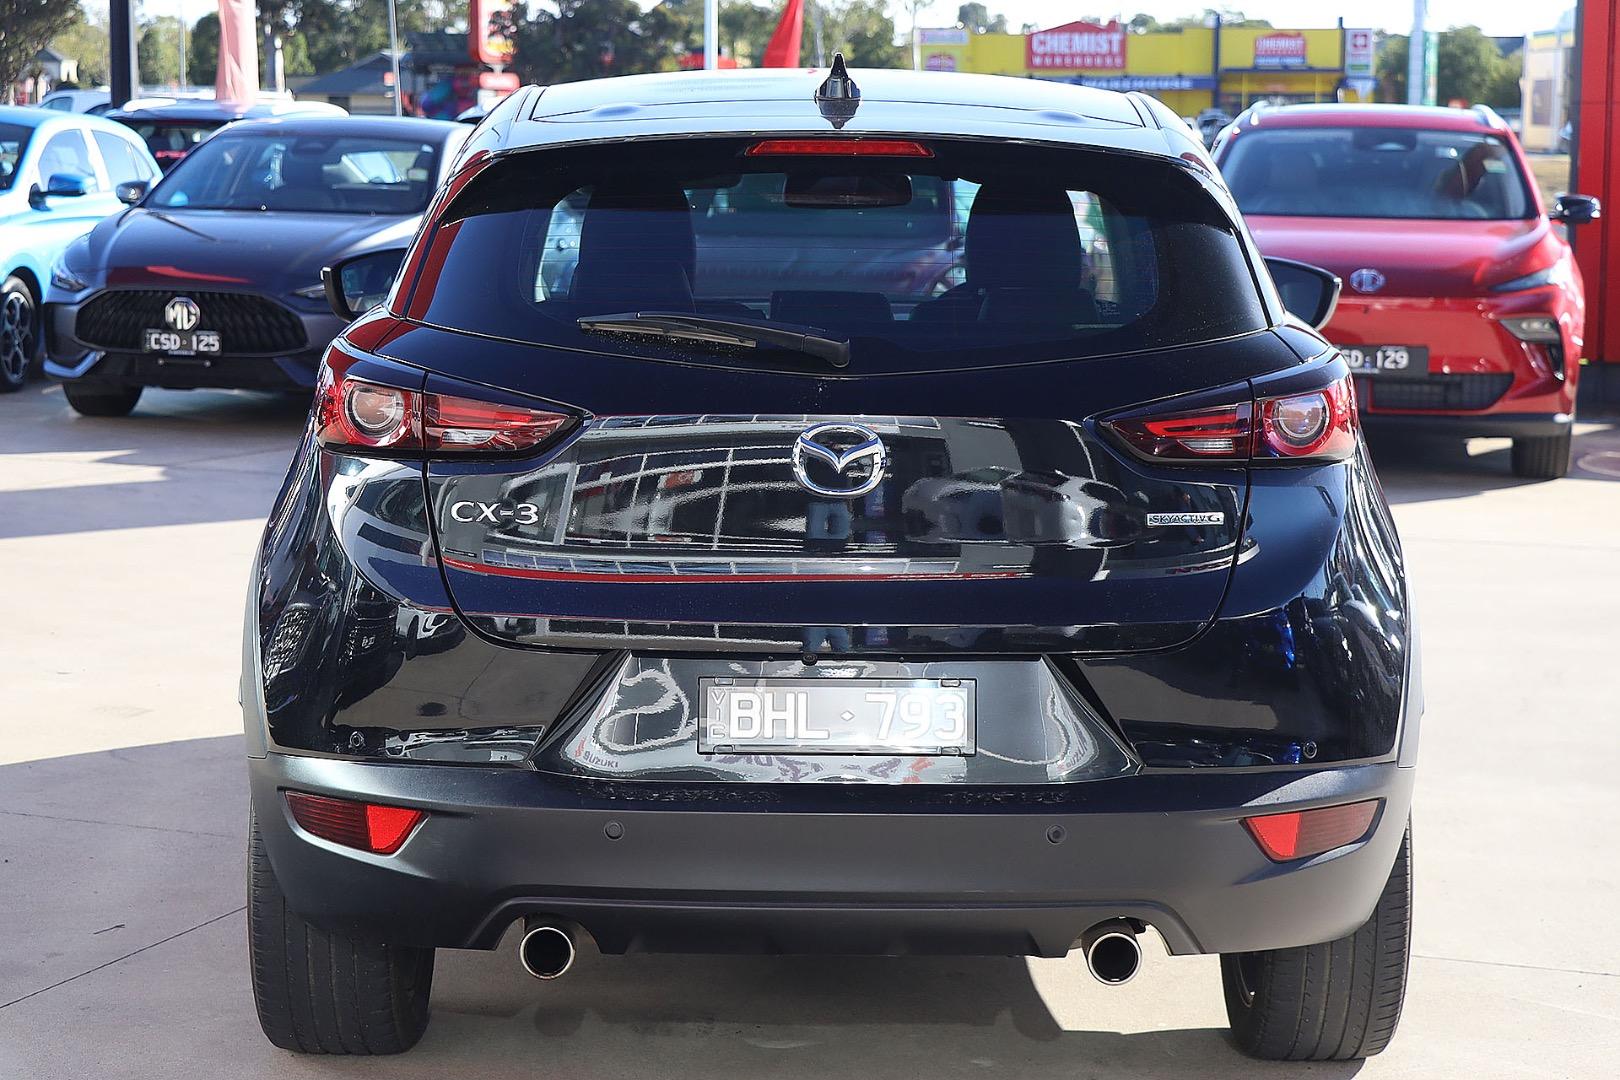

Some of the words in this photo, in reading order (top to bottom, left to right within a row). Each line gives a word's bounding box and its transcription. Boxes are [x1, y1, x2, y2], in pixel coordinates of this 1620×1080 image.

[1031, 32, 1122, 54] CHEMIST
[168, 301, 197, 330] MG
[150, 333, 181, 350] CSD
[191, 334, 220, 352] 125
[1341, 349, 1364, 367] SD
[1376, 350, 1409, 369] 129
[450, 501, 540, 525] CX-3
[729, 691, 830, 740] BHL
[864, 692, 966, 741] 793
